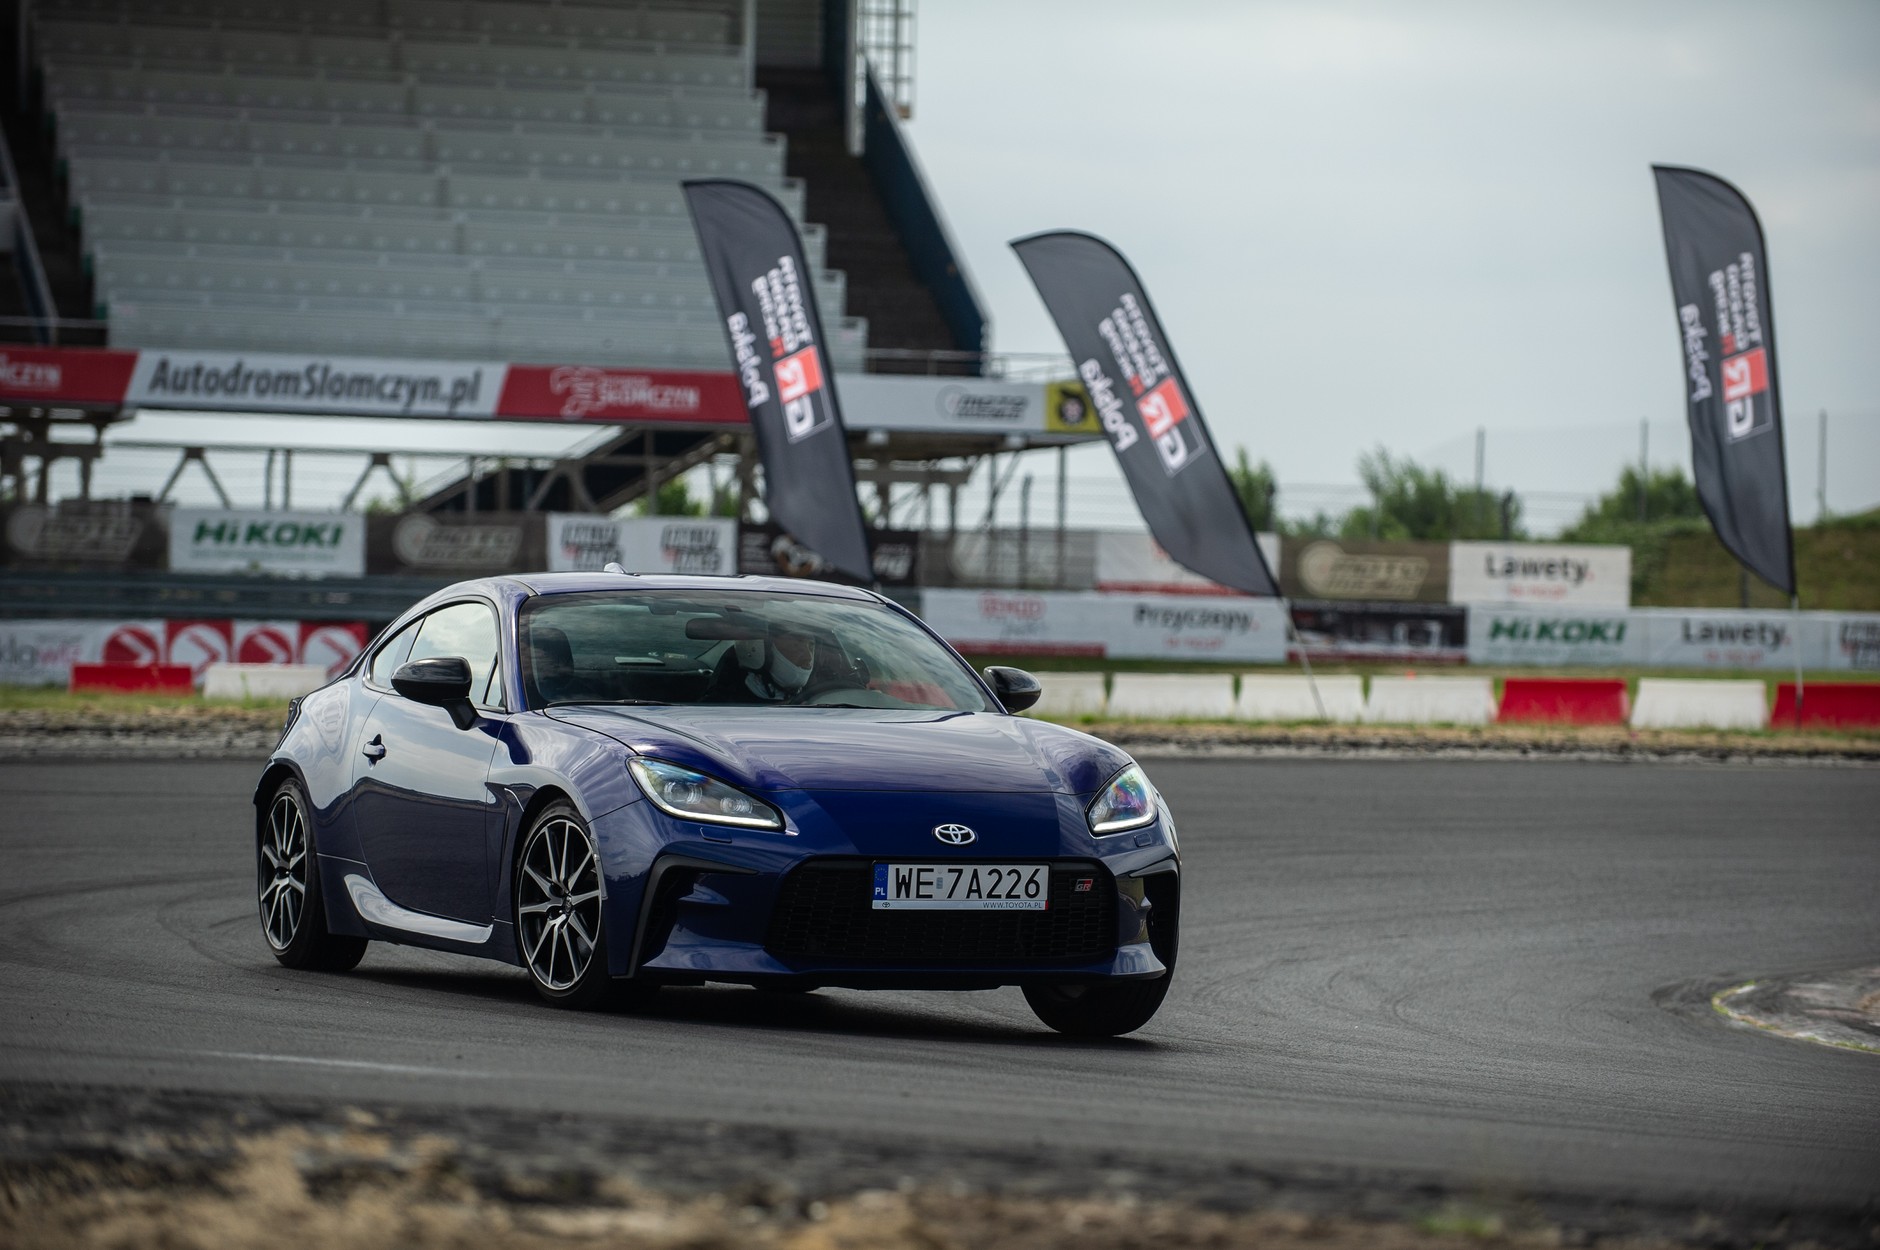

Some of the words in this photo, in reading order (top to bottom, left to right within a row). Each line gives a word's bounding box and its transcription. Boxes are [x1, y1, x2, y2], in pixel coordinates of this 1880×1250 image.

[895, 867, 935, 899] WE
[947, 868, 1041, 899] 7A226
[874, 887, 886, 896] PL
[982, 901, 1042, 909] WWW.TOYOTA.PL
